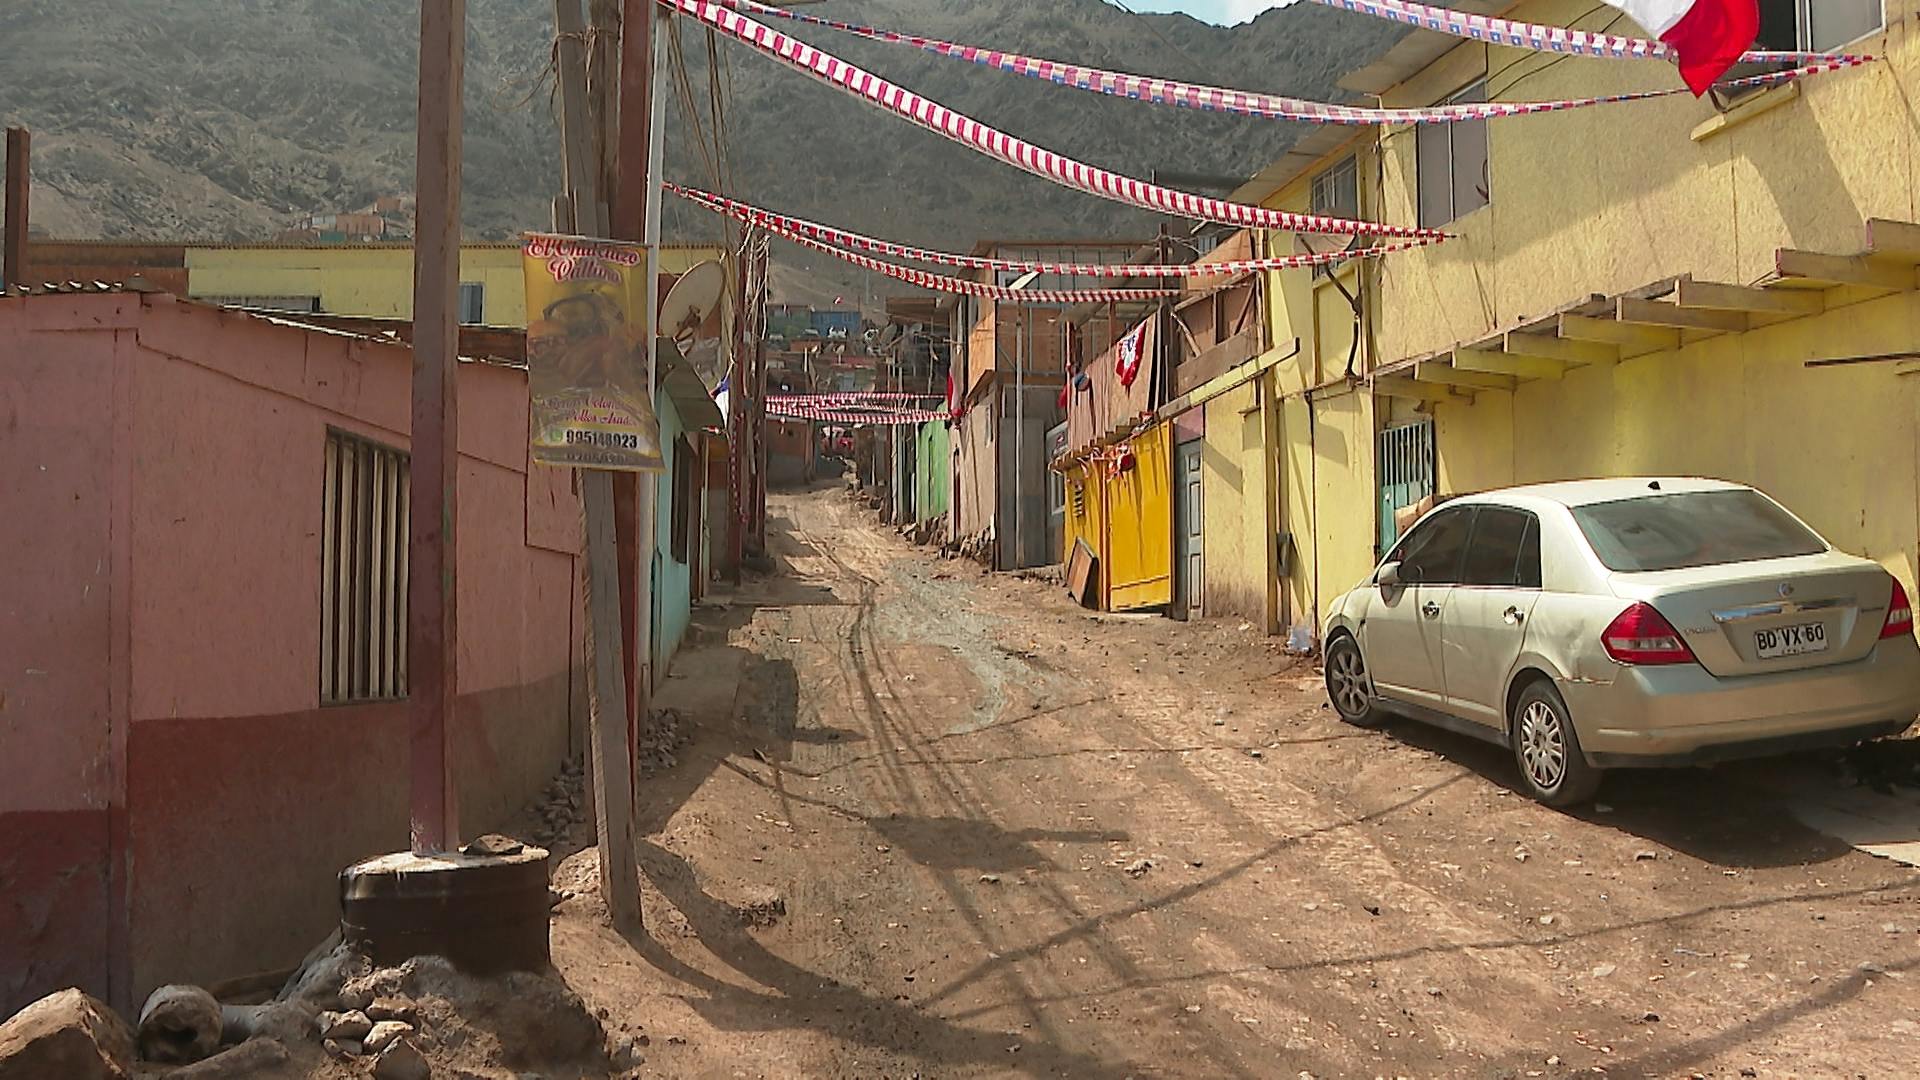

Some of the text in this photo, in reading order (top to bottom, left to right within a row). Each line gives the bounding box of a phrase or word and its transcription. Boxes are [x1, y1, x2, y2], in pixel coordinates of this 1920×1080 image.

[527, 237, 552, 257] El
[1757, 625, 1824, 650] BD VX 60
